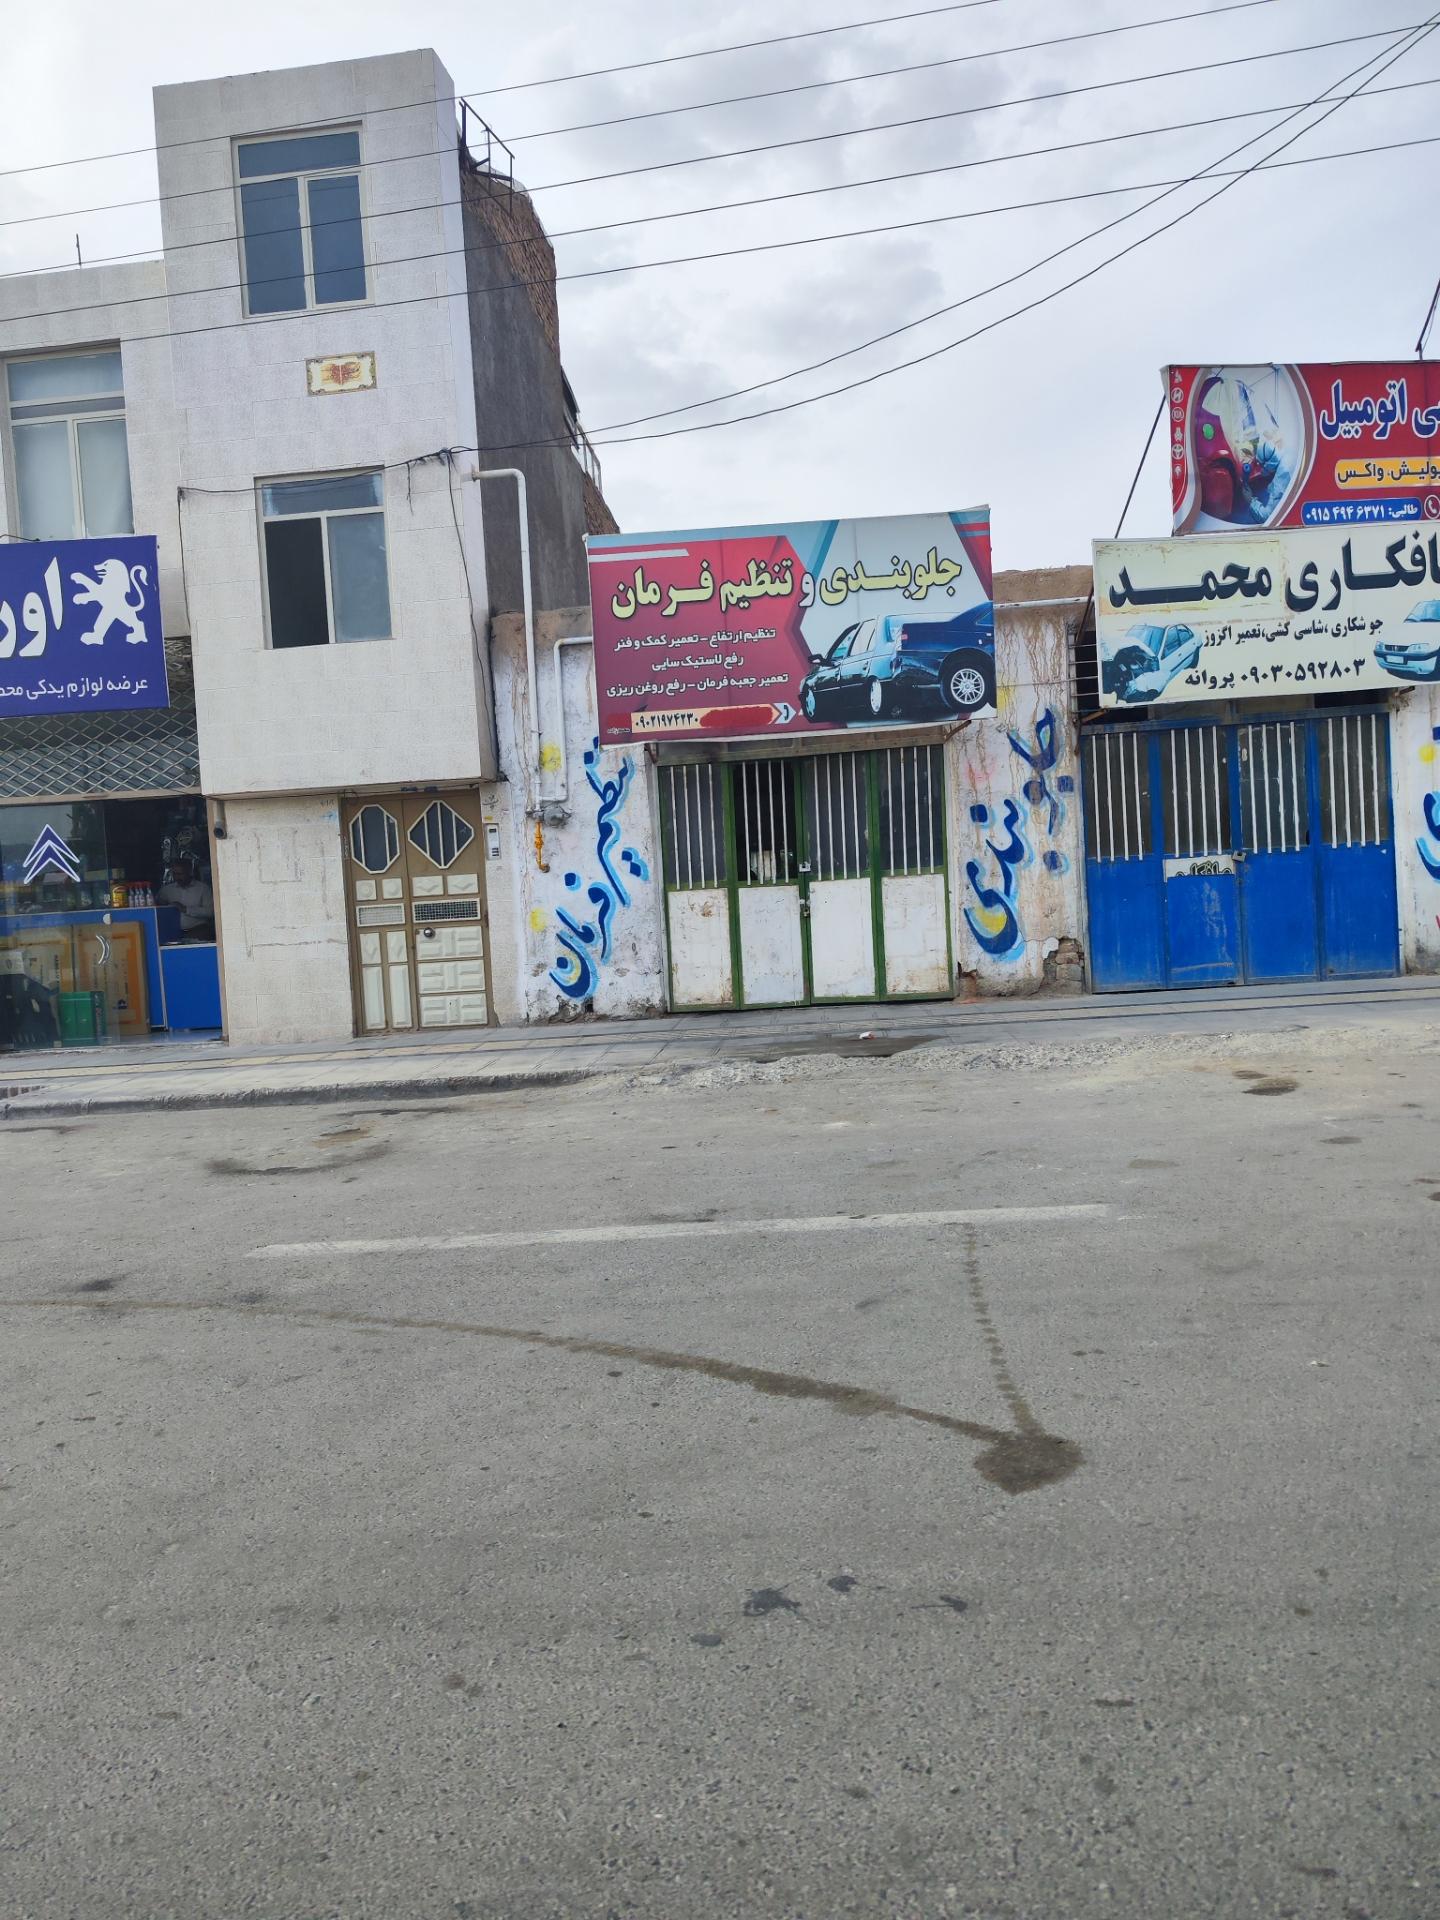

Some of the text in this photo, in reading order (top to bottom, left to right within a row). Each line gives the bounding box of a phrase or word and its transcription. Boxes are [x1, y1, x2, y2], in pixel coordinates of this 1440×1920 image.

[1320, 377, 1408, 441] اتومبیل
[1337, 461, 1385, 484] واکس
[1305, 506, 1331, 521] ۰۹۱۵
[1387, 503, 1419, 519] طالبی:
[611, 545, 963, 620] جلوبندی و تنظیم فرمان
[1109, 561, 1273, 609] محمد
[613, 636, 633, 652] فنر
[641, 633, 668, 646] کمک
[668, 633, 699, 648] تعمیر
[709, 630, 743, 648] ارتفاع
[743, 627, 776, 643] تنظیم
[1203, 624, 1232, 648] اگزوز
[651, 651, 744, 672] رفع لاستیک سایی
[729, 676, 757, 688] جعبه
[758, 672, 790, 687] تعمیر
[1184, 658, 1366, 690] ۰۹۰۳۰۵۹۲۸۰۳ پروانه
[25, 679, 65, 700] یدکی
[67, 676, 103, 698] لوازم
[106, 675, 149, 695] عرضه
[606, 683, 634, 698] ریزی
[635, 681, 665, 696] روغن
[665, 678, 686, 696] رفع
[697, 675, 729, 692] فرمان
